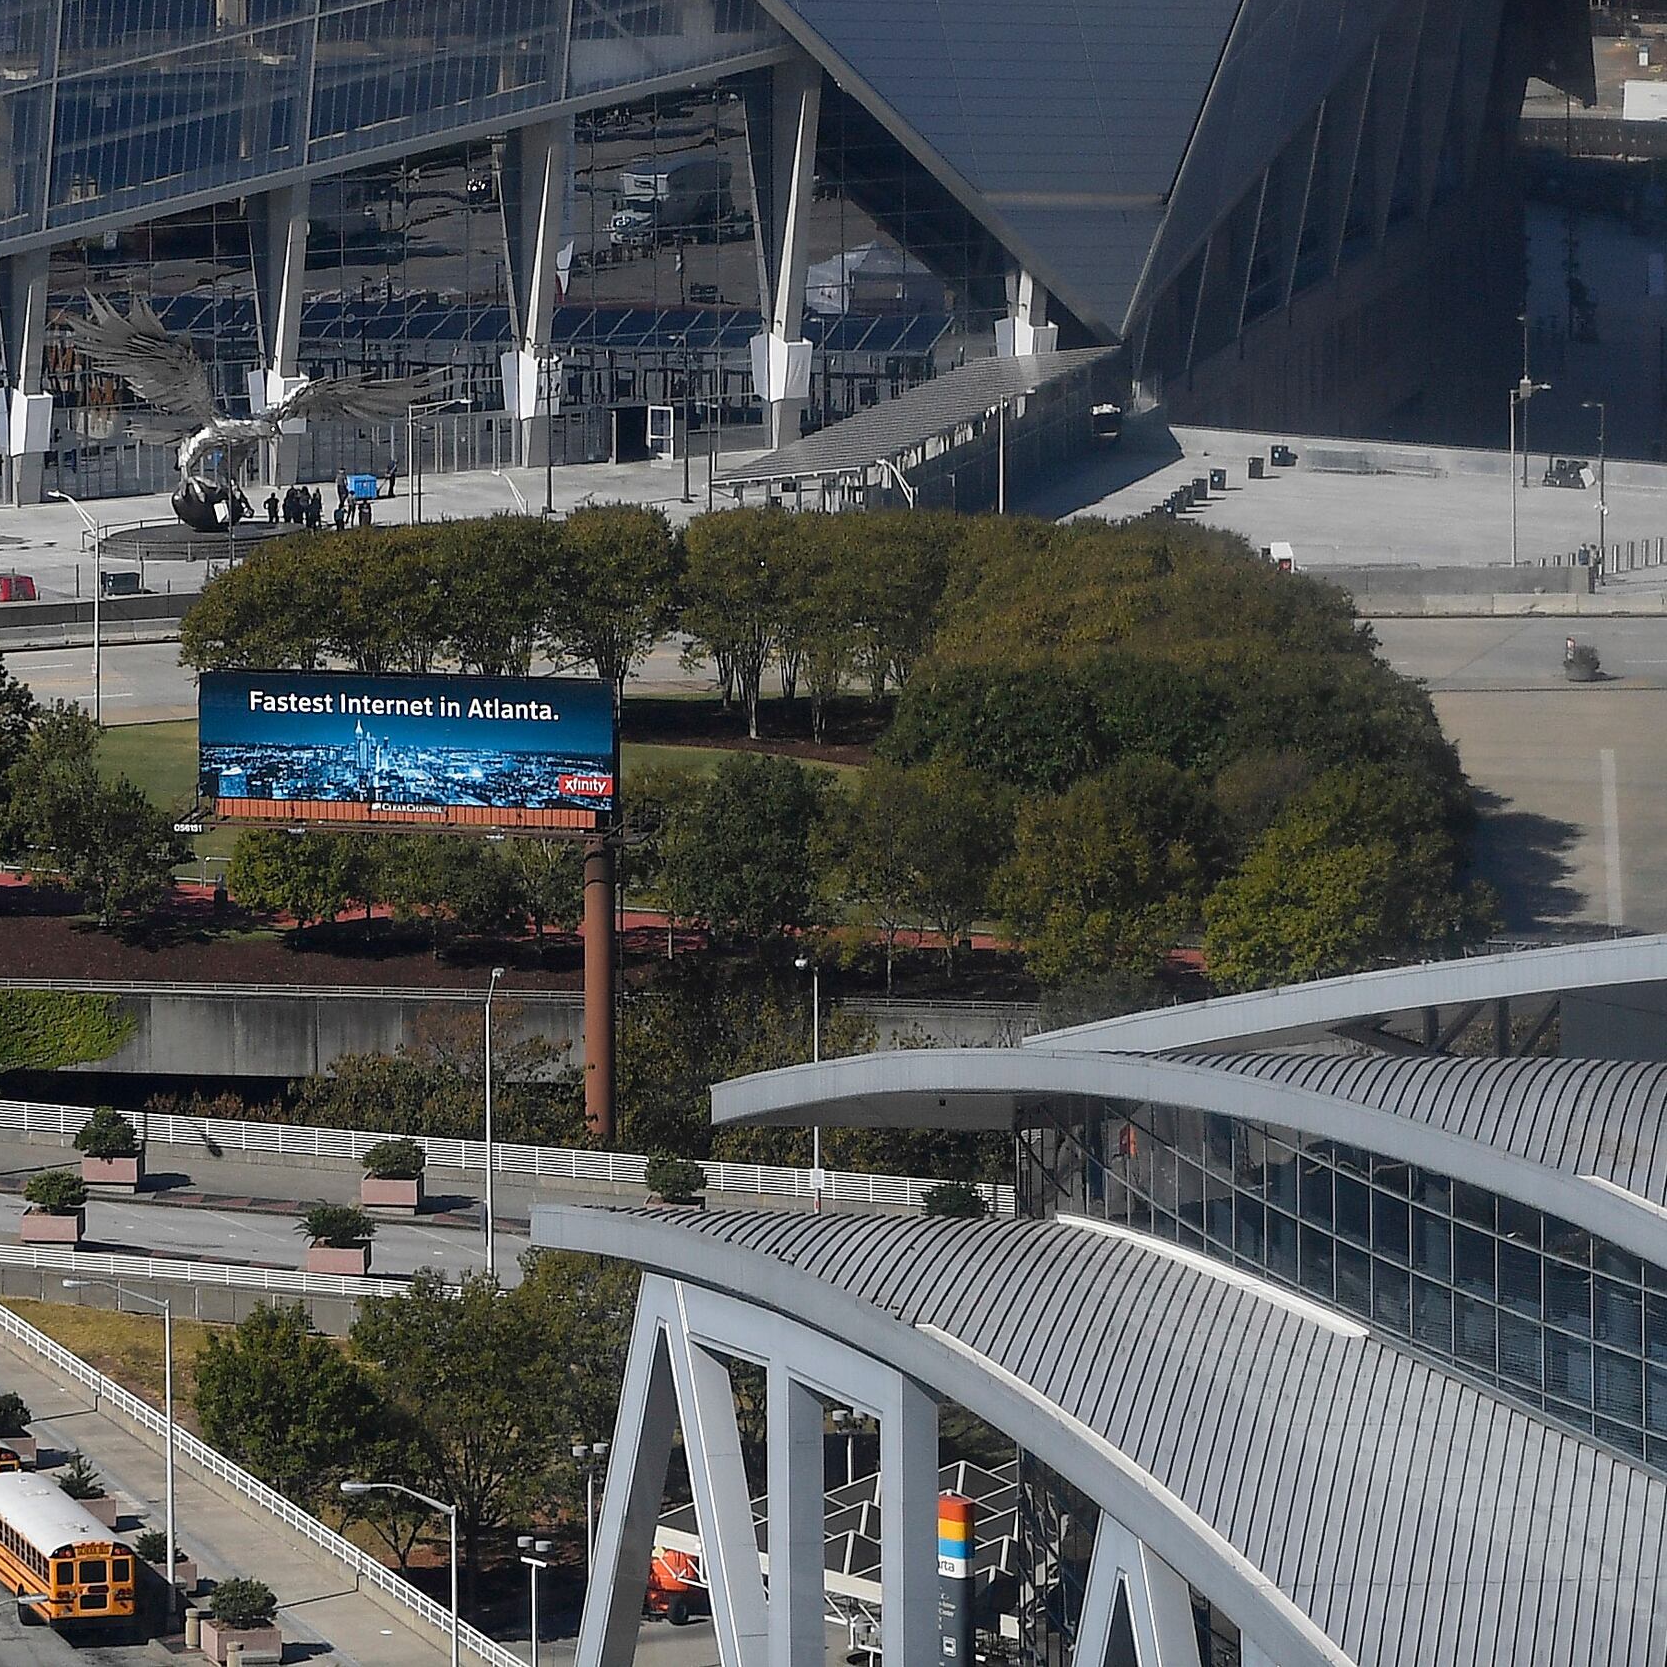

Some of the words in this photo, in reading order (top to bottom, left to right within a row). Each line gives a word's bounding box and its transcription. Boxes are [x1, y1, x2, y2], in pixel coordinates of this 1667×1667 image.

[249, 691, 334, 714] Fastest
[339, 693, 434, 718] Internet
[439, 695, 460, 718] in
[467, 697, 560, 721] Atlanta.
[565, 776, 607, 794] xfinity
